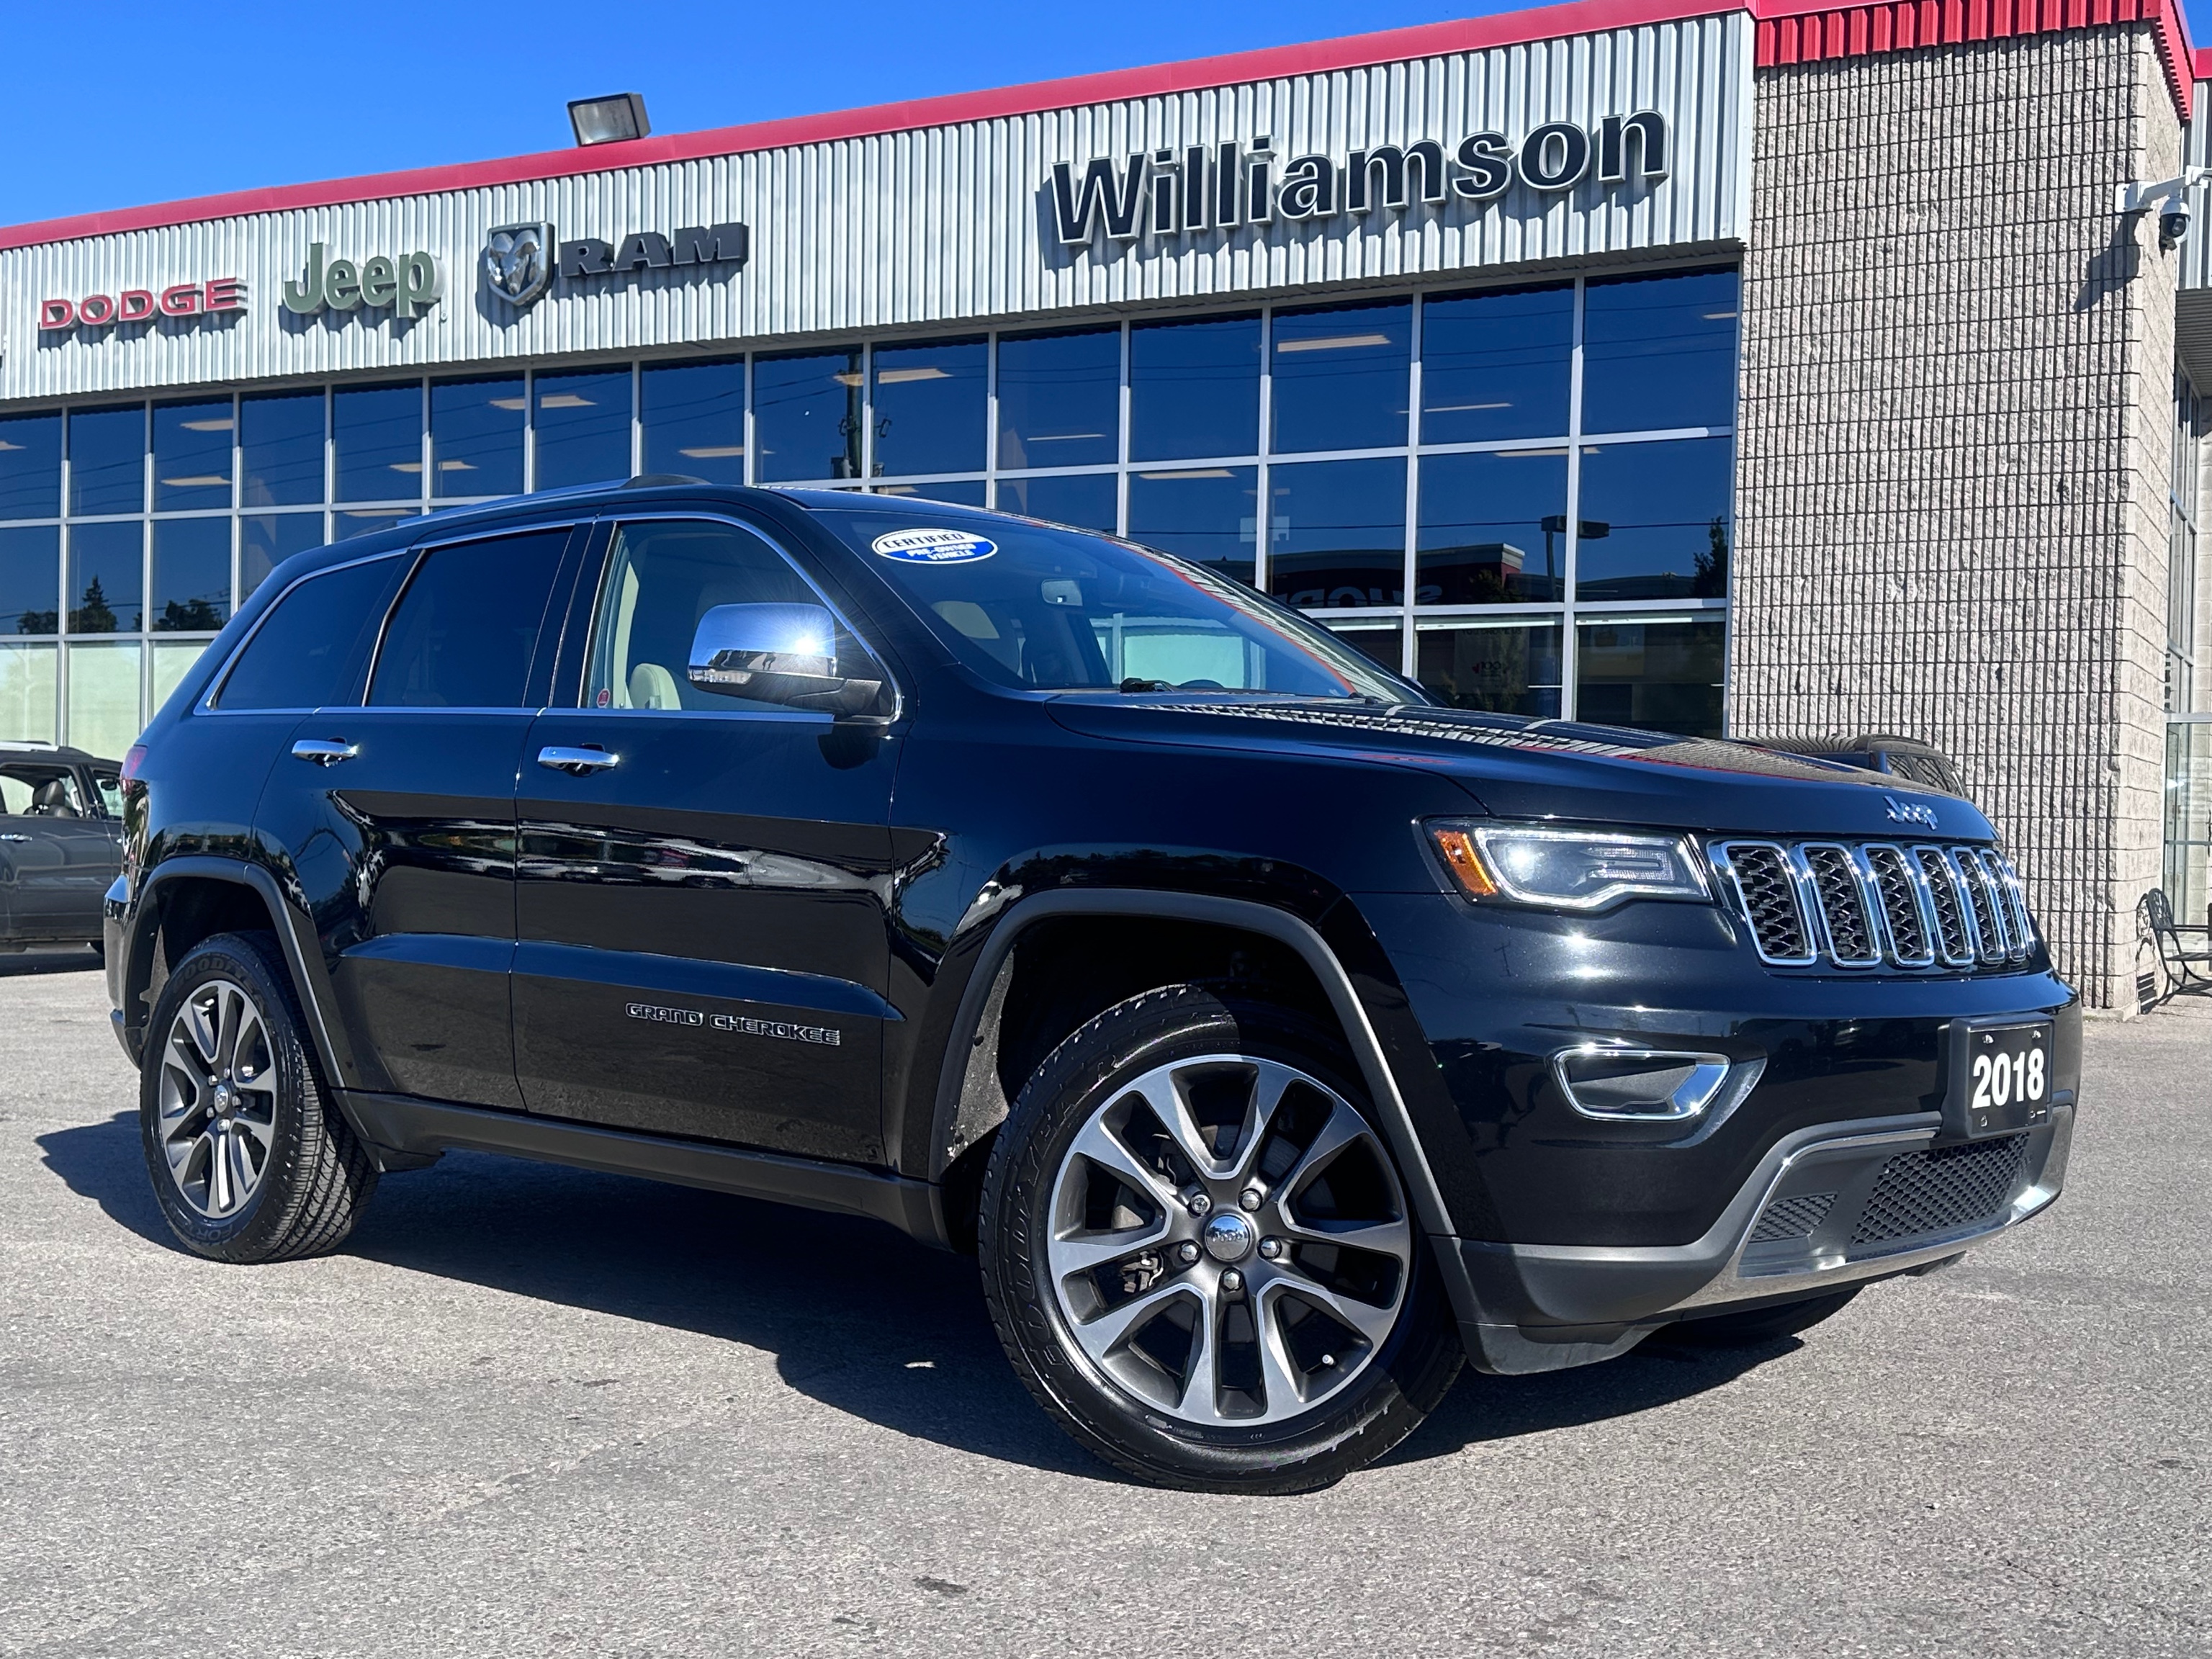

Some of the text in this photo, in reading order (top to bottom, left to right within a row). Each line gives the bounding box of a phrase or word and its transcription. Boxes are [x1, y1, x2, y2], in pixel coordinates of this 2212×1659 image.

[1051, 108, 1669, 245] Williamson
[559, 222, 748, 278] RAM
[38, 276, 246, 331] DODGE
[283, 242, 442, 319] Jeep
[883, 533, 966, 549] CERTIFIED
[907, 543, 976, 557] PRE-OWNED
[927, 549, 975, 560] VEHICLE
[1884, 796, 1938, 830] Jeep
[626, 1002, 840, 1046] GRAND CHEROKEE
[1972, 1048, 2044, 1109] 2018
